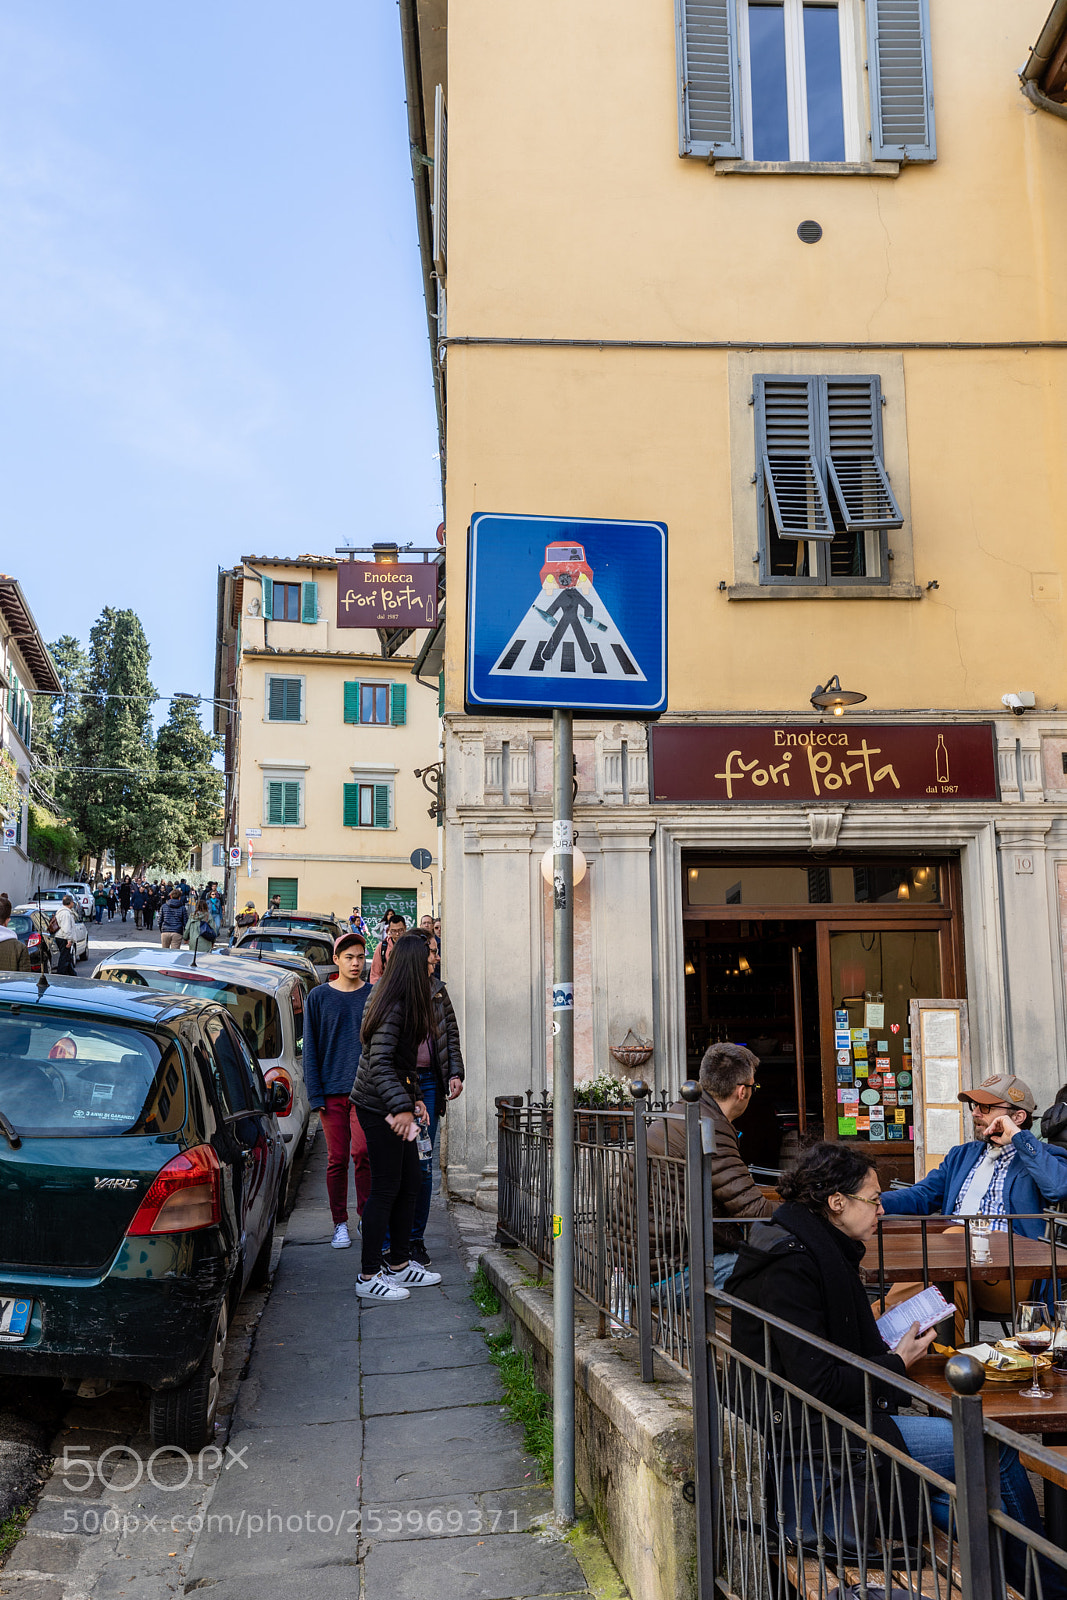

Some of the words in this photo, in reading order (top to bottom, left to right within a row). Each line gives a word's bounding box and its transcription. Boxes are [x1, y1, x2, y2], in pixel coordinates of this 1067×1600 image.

[364, 572, 413, 583] Enoteca
[773, 730, 850, 747] Enoteca
[925, 785, 938, 794] dal
[941, 785, 959, 794] 1987
[94, 1176, 140, 1190] YARIS
